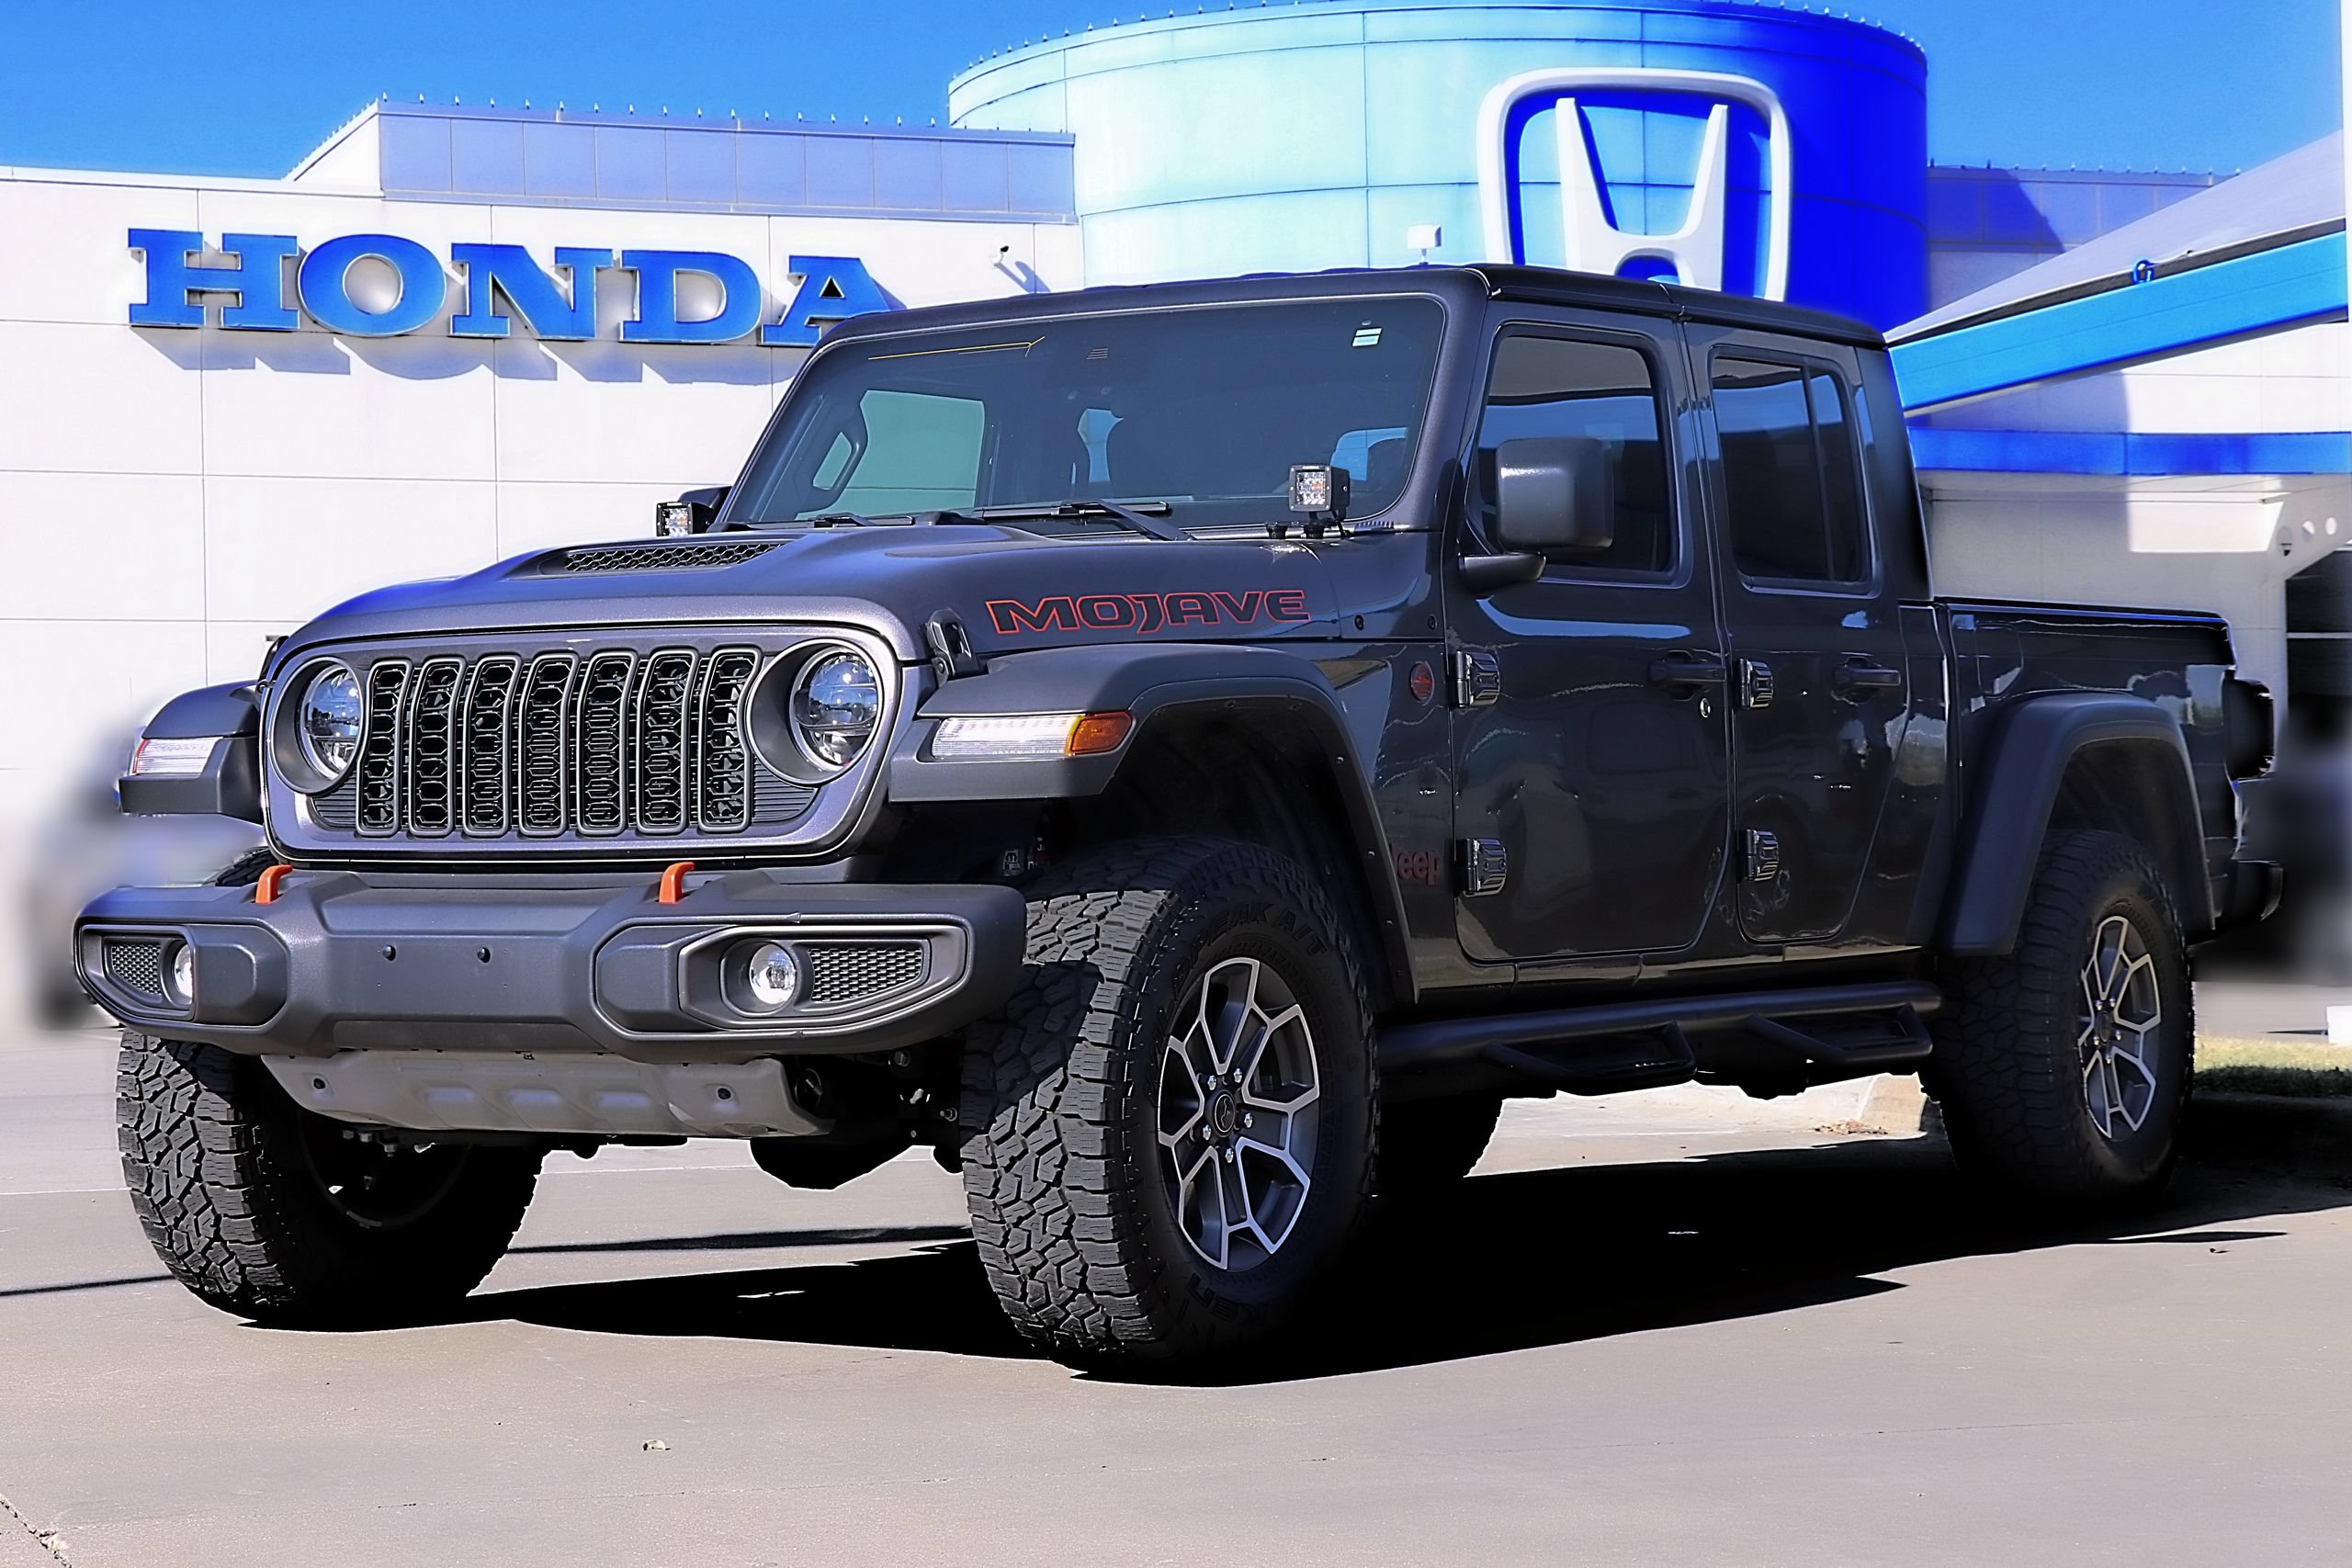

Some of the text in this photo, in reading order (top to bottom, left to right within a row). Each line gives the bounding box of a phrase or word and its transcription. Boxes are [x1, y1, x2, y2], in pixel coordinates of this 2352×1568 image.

[128, 228, 890, 345] HONDA
[985, 590, 1310, 634] MOJAVE
[1388, 843, 1441, 888] eep
